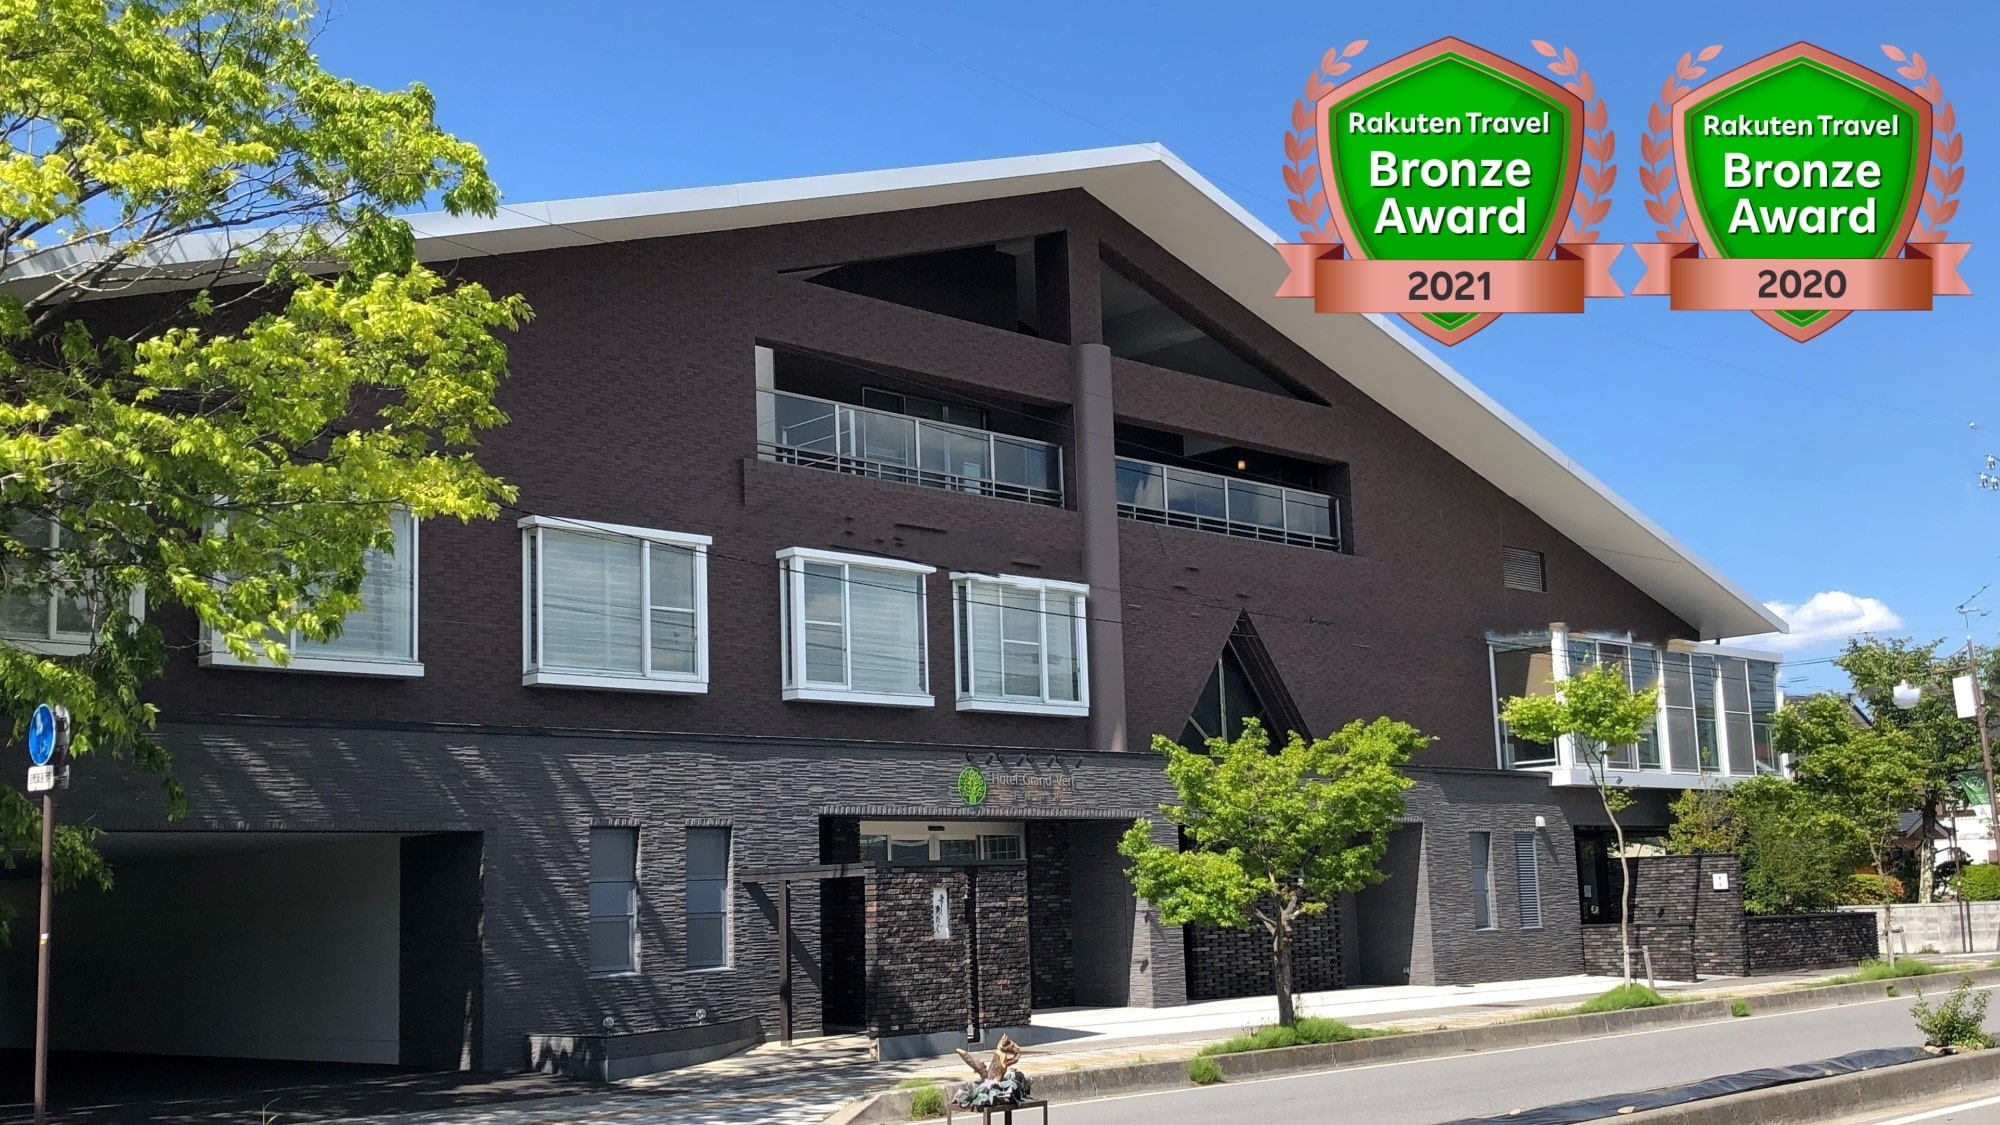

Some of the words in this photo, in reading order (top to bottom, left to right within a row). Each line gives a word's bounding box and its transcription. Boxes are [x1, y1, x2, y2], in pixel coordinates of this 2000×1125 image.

[991, 772, 1018, 786] Hotel
[1022, 773, 1052, 787] Grand
[1055, 774, 1075, 788] Vert
